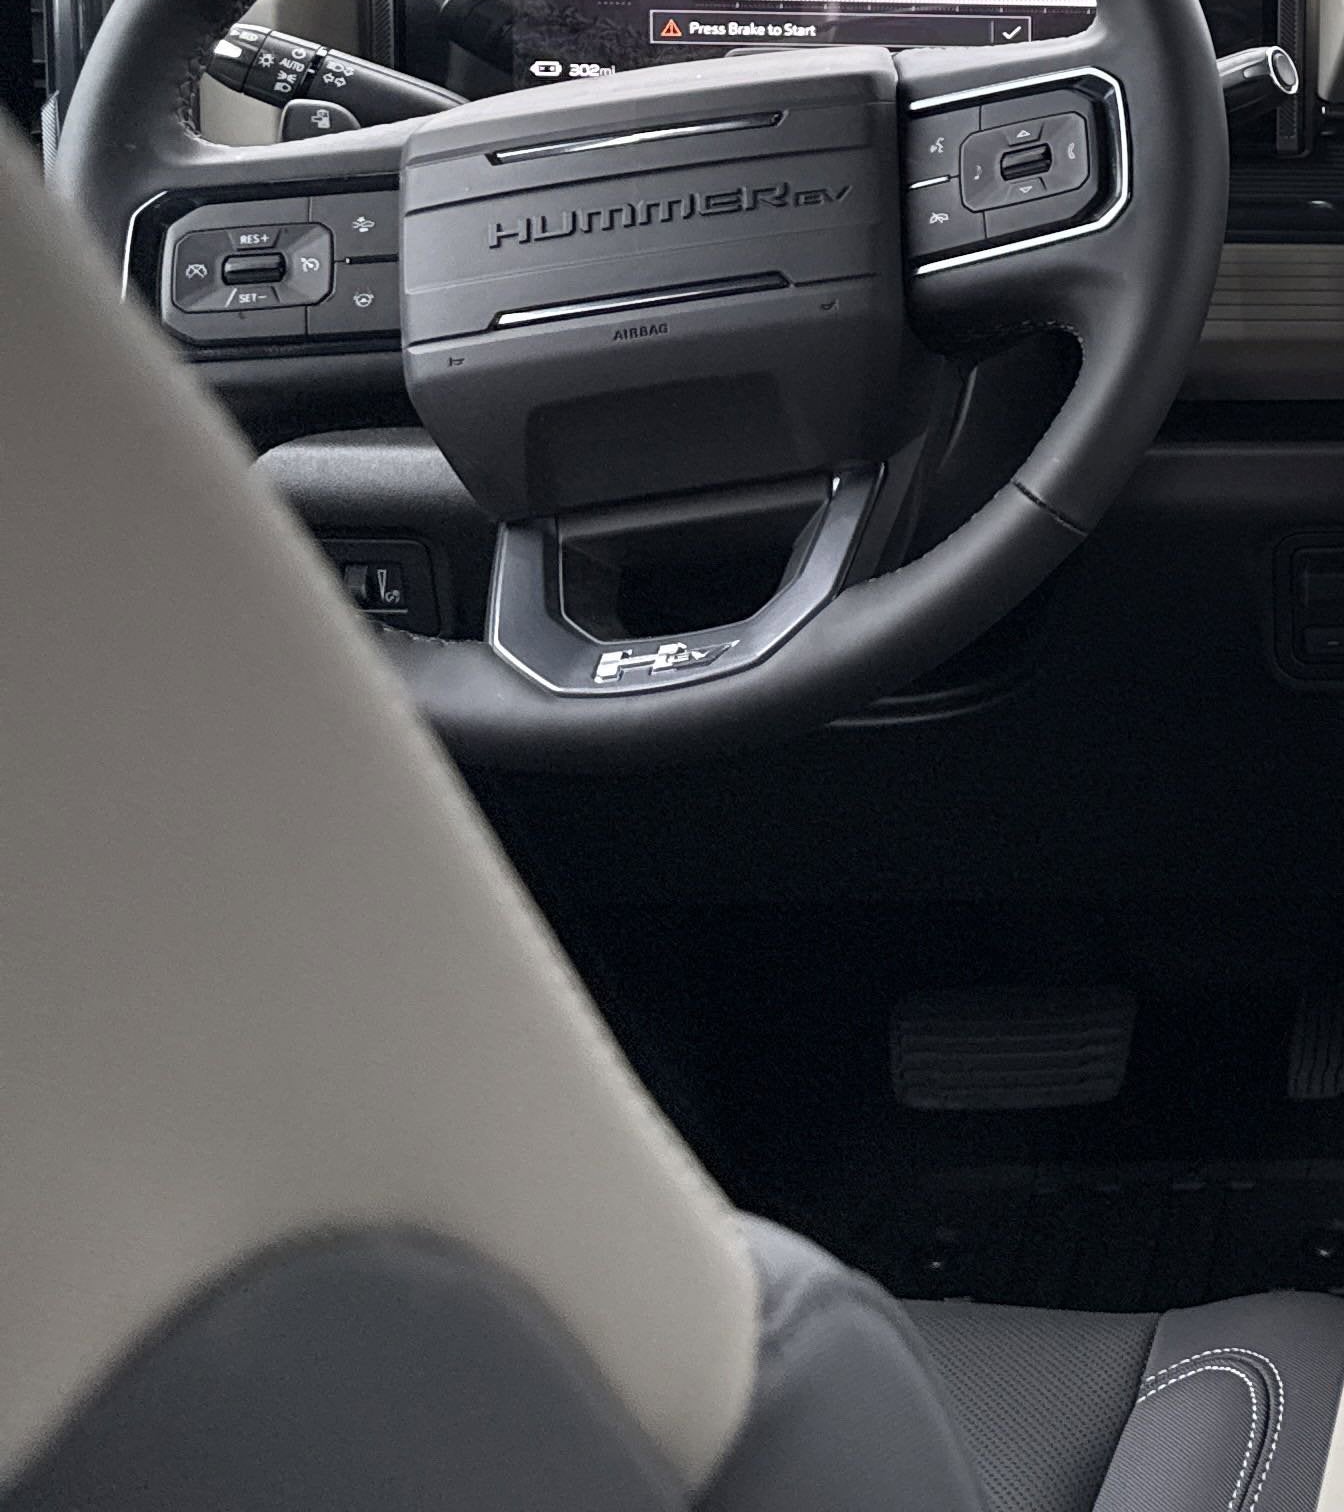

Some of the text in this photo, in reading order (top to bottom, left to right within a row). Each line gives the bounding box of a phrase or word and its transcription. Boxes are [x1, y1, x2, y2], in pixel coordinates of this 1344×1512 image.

[689, 22, 816, 37] Press Brake to Start
[279, 58, 305, 72] AUTO
[488, 182, 852, 249] HUMMER EV
[240, 234, 270, 245] RES+
[613, 323, 669, 341] AIRBAG
